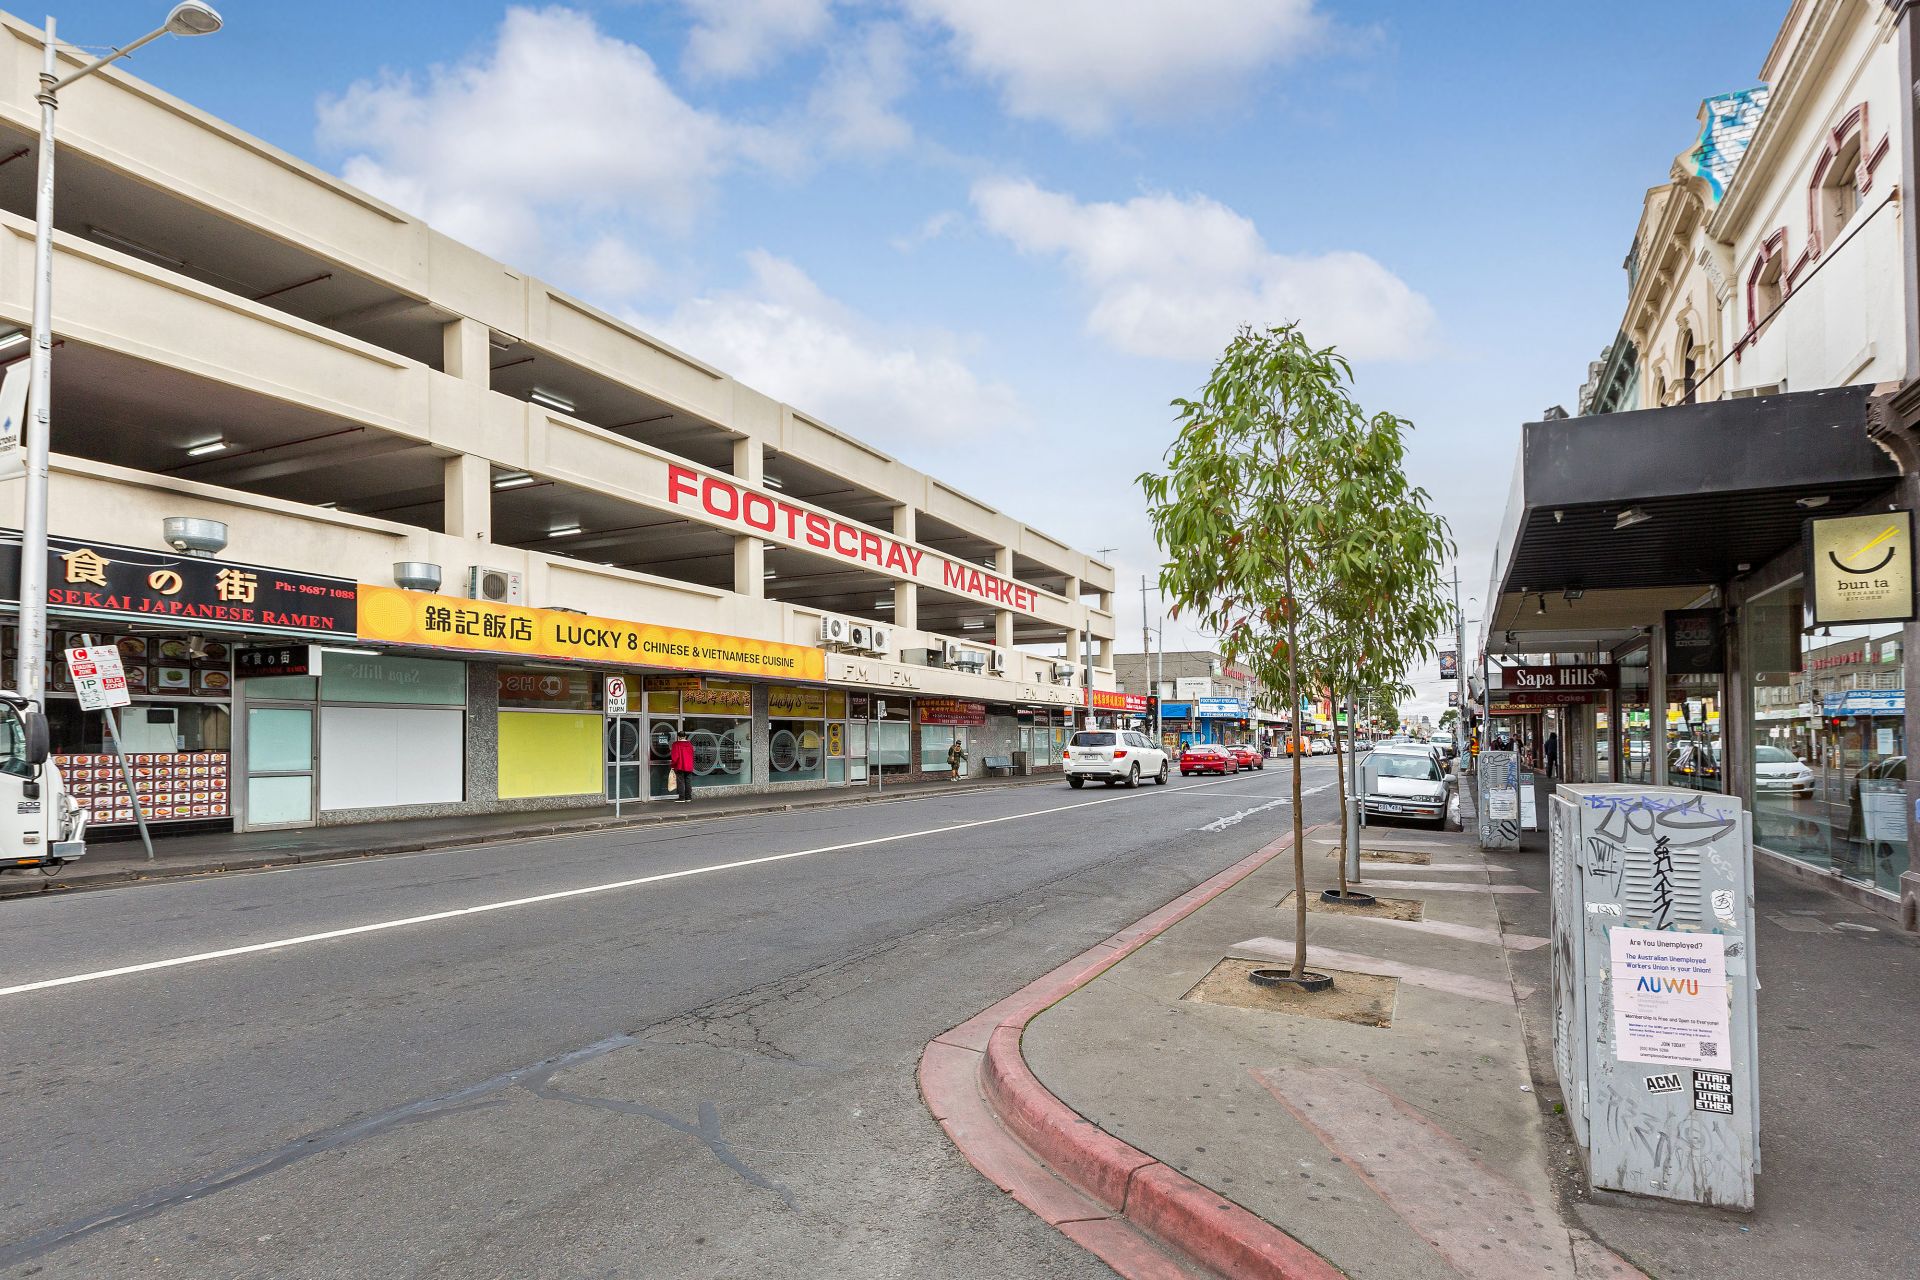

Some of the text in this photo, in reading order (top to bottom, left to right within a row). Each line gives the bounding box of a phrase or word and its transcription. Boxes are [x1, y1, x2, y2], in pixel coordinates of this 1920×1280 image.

[668, 464, 1038, 613] FOOTSCRAY MARKET
[60, 548, 258, 603] 食の街
[275, 581, 355, 600] Ph: 9687 1088
[1837, 579, 1889, 591] bun ta
[48, 588, 334, 630] SEKAI JAPANESE RAMEN
[424, 605, 533, 641] 錦記飯店
[556, 624, 638, 651] LUCKY 8
[643, 641, 794, 668] CHINESE & VIETNAMESE CUISINE
[1516, 668, 1596, 689] Sapa Hills
[1642, 939, 1655, 947] You
[1657, 940, 1703, 950] Unemployed?
[1625, 962, 1651, 970] Workers
[1637, 953, 1668, 961] Australian
[1669, 955, 1706, 964] Unemployed
[1636, 976, 1698, 995] AUWU
[1646, 1074, 1681, 1091] ACM
[1694, 1080, 1731, 1093] ETHER
[1697, 1072, 1727, 1084] UTAH
[1695, 1100, 1732, 1112] ETHER
[1698, 1091, 1728, 1103] UTAH
